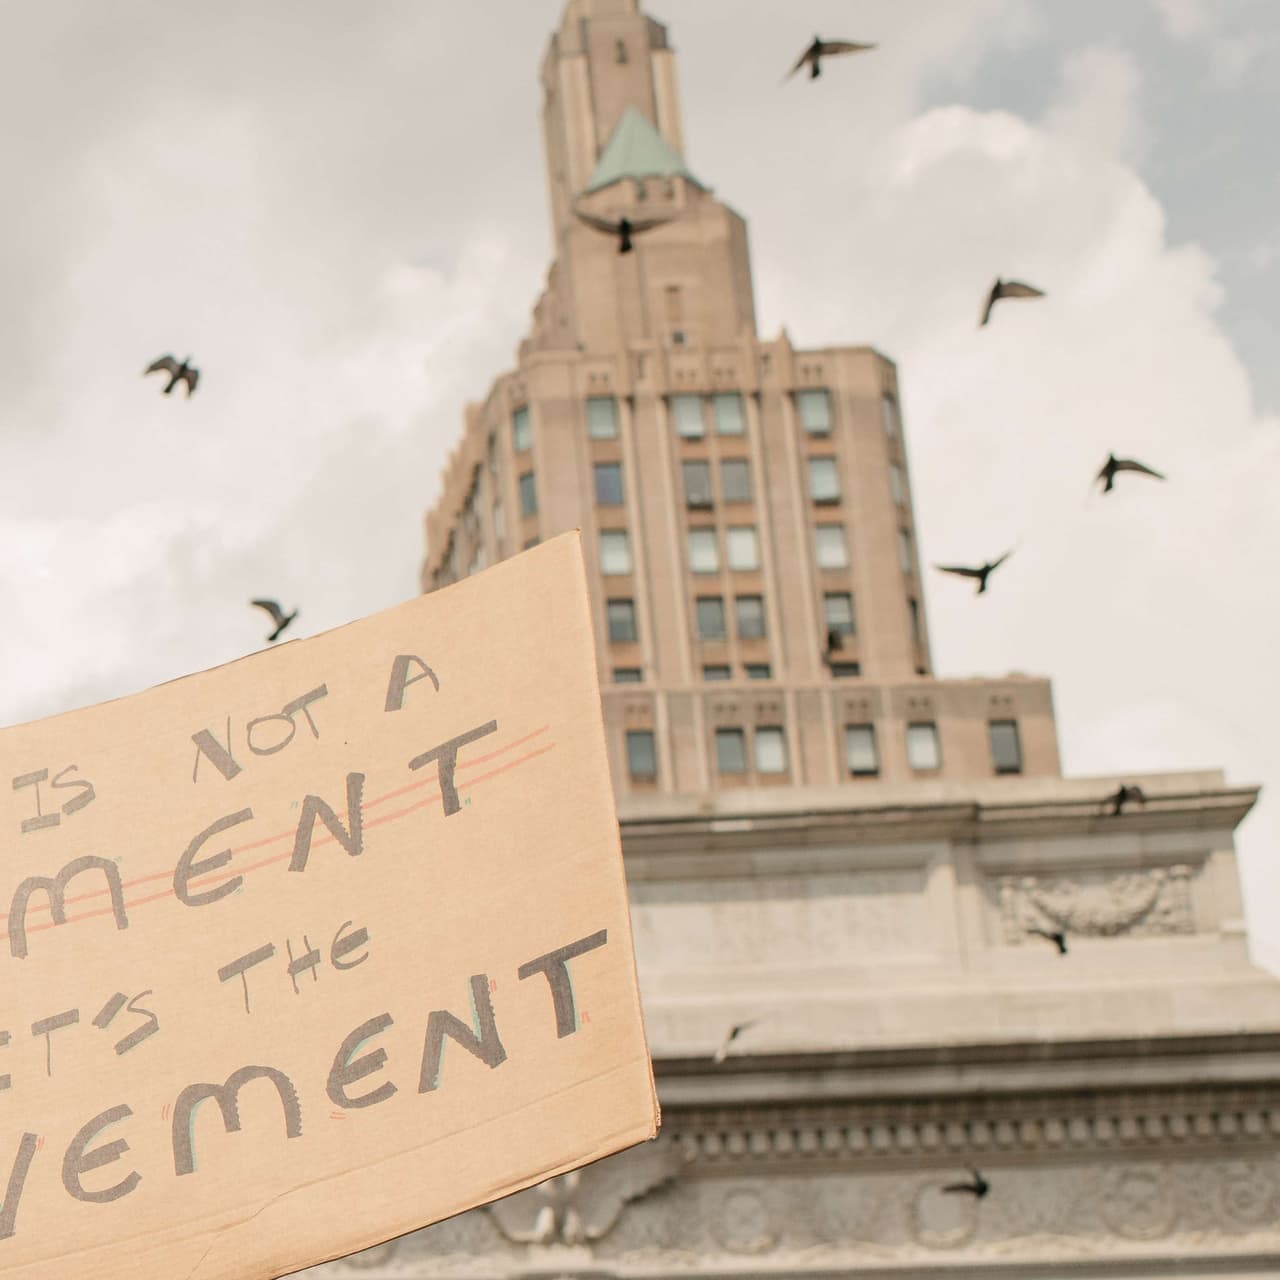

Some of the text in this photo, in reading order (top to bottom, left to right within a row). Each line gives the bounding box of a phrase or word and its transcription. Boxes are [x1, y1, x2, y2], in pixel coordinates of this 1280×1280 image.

[12, 763, 97, 834] IS
[191, 683, 330, 784] NOT
[384, 653, 441, 713] A
[217, 919, 371, 1014] THE
